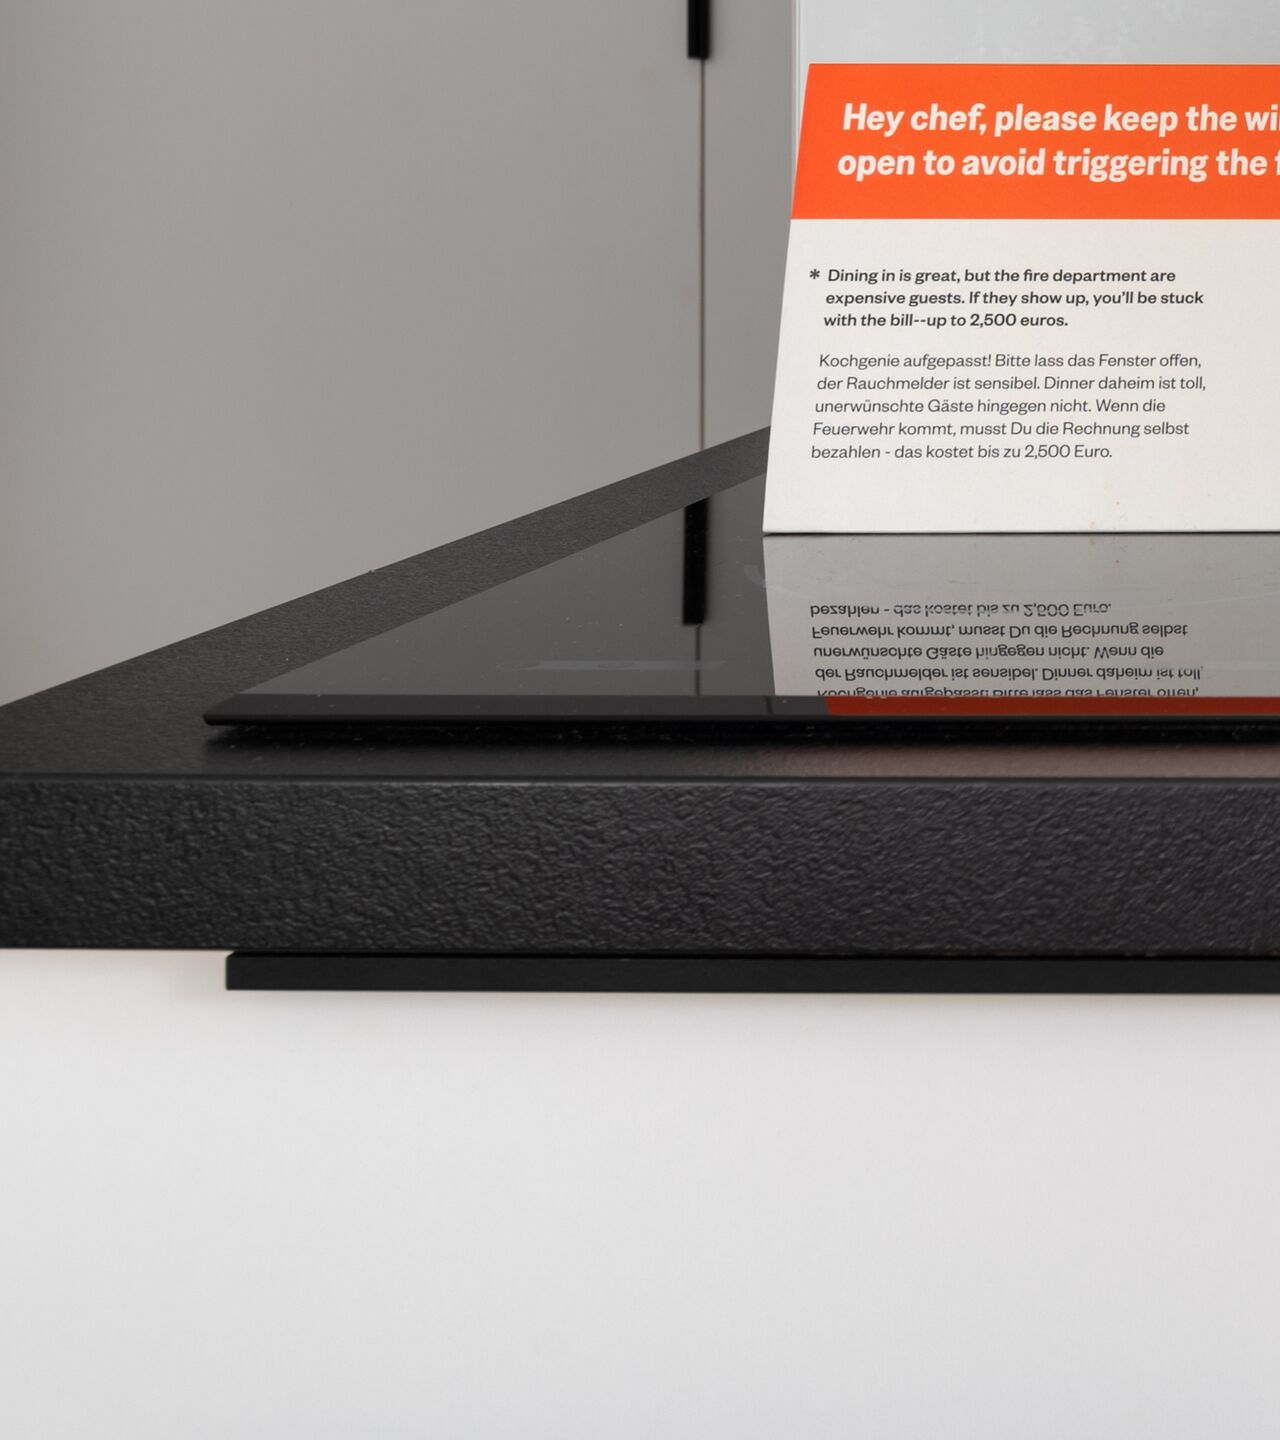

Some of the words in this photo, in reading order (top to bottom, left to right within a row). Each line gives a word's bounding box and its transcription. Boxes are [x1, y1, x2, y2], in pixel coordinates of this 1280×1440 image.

[842, 102, 905, 138] Hey
[910, 102, 987, 136] chef,
[993, 103, 1097, 138] please
[1103, 103, 1179, 138] keep
[1185, 103, 1238, 132] the
[837, 154, 916, 182] open
[922, 150, 956, 176] to
[961, 147, 1046, 176] avoid
[1052, 147, 1209, 183] triggering
[1215, 147, 1268, 176] the
[828, 268, 879, 285] Dining
[881, 268, 896, 282] in
[899, 268, 912, 282] is
[914, 270, 961, 285] great,
[964, 269, 991, 282] but
[994, 269, 1020, 282] the
[1023, 268, 1049, 282] fire
[1052, 269, 1147, 285] department
[1150, 272, 1176, 282] are
[825, 291, 906, 307] expensive
[908, 292, 965, 307] guests.
[969, 291, 981, 304] If
[982, 291, 1018, 307] they
[1020, 291, 1063, 304] show
[1065, 294, 1089, 307] up,
[1137, 291, 1157, 304] be
[1160, 291, 1204, 304] stuck
[823, 313, 857, 327] with
[860, 313, 887, 327] the
[950, 315, 967, 327] to
[969, 313, 1017, 328] 2,500
[1020, 316, 1068, 327] euros.
[819, 354, 900, 371] Kochgenie
[903, 353, 992, 371] aufgepasst!
[995, 353, 1031, 367] Bitte
[1034, 353, 1064, 367] lass
[1067, 353, 1095, 367] das
[1098, 353, 1157, 367] Fenster
[1159, 353, 1202, 369] offen,
[817, 376, 844, 390] der
[846, 376, 950, 390] Rauchmelder
[953, 376, 971, 390] ist
[974, 376, 1040, 390] sensibel.
[1044, 376, 1096, 390] Dinner
[1098, 376, 1155, 390] daheim
[1158, 376, 1176, 390] ist
[1180, 375, 1206, 391] toll,
[815, 399, 924, 413] unerwünschte
[927, 398, 974, 413] Gäste
[977, 399, 1047, 416] hingegen
[1050, 399, 1092, 413] nicht.
[1095, 398, 1139, 413] Wenn
[1142, 398, 1166, 413] die
[813, 422, 896, 436] Feuerwehr
[898, 422, 956, 437] kommt,
[960, 424, 1007, 436] musst
[1010, 421, 1032, 435] Du
[1035, 421, 1059, 435] die
[1062, 421, 1141, 438] Rechnung
[1143, 421, 1189, 435] selbst
[811, 445, 881, 459] bezahlen
[894, 445, 923, 459] das
[926, 445, 974, 459] kostet
[977, 444, 1000, 458] bis
[1003, 448, 1021, 458] zu
[1024, 444, 1071, 460] 2,500
[1074, 444, 1113, 458] Euro.
